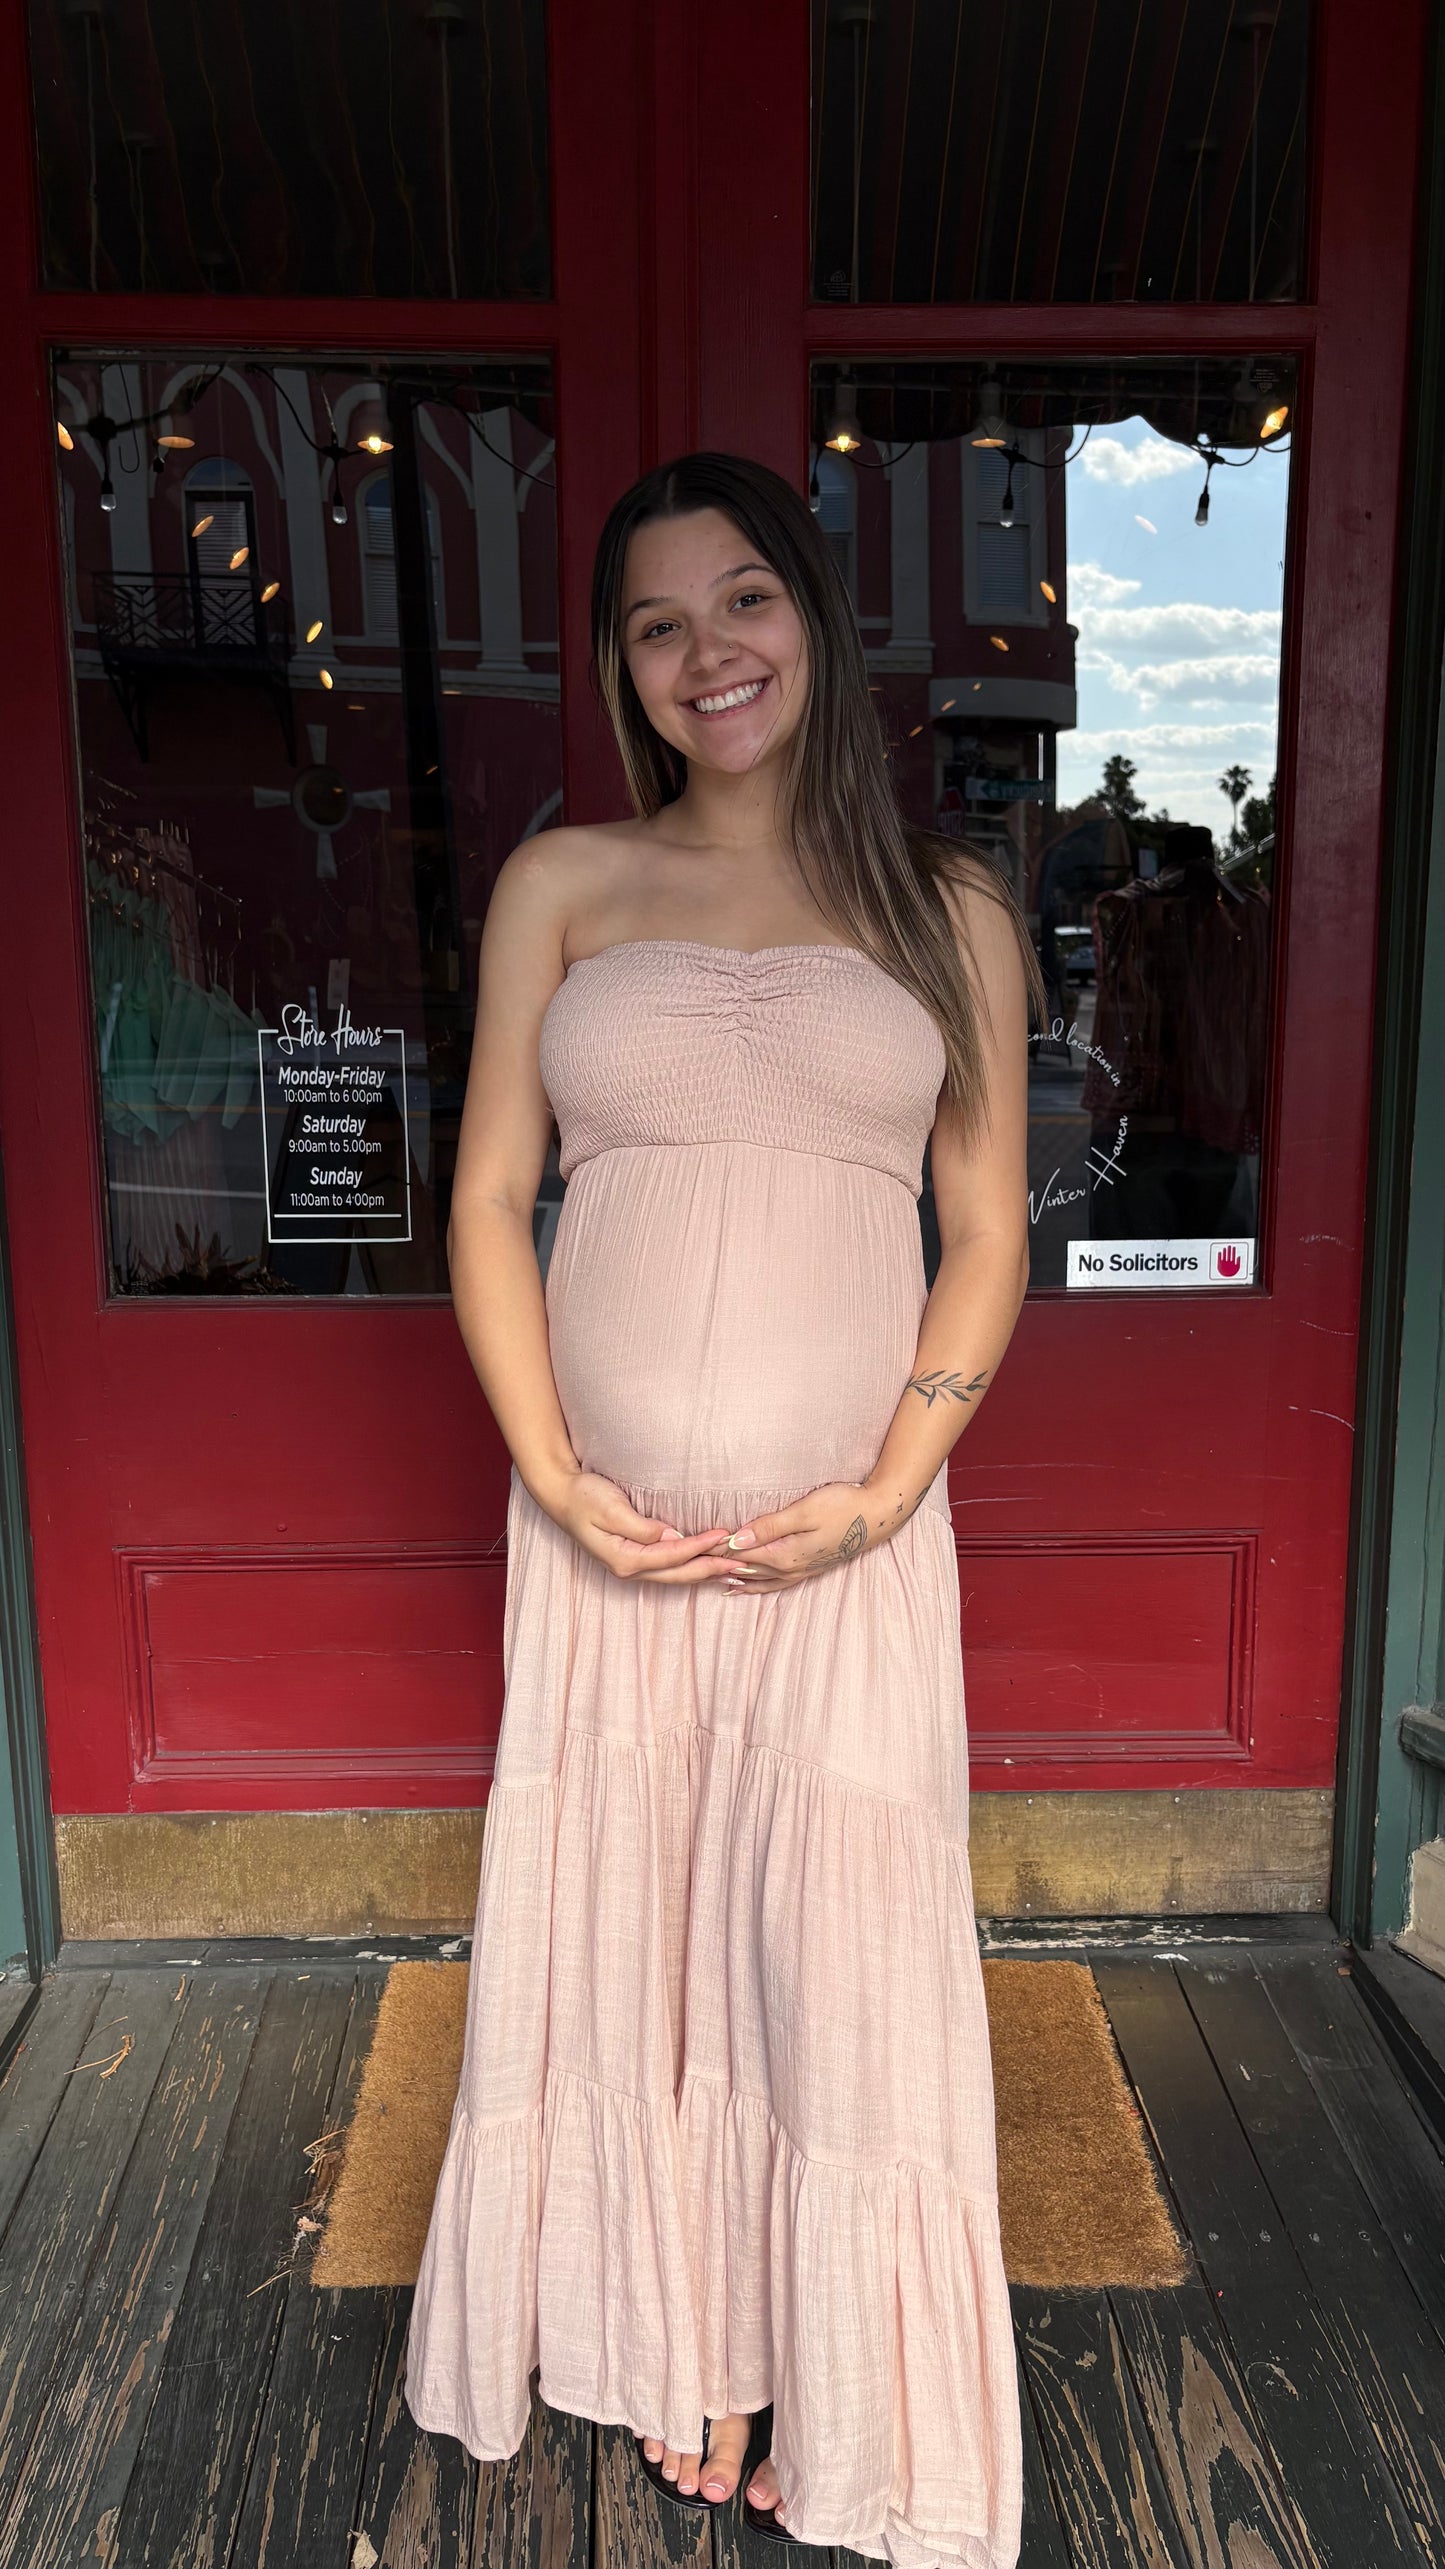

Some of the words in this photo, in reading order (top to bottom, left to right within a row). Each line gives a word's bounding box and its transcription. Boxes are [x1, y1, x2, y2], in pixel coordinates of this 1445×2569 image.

[277, 1003, 327, 1056] Store
[331, 1003, 384, 1056] Hours
[1066, 1022, 1112, 1073] location
[1110, 1072, 1121, 1088] in
[278, 1066, 386, 1089] Monday-Friday
[284, 1089, 327, 1103] 10:00am
[329, 1090, 341, 1103] to
[302, 1114, 366, 1137] Saturday
[288, 1139, 327, 1153] 9:00am
[329, 1140, 341, 1153] to
[1085, 1115, 1128, 1191] Haven
[310, 1166, 363, 1189] Sunday
[290, 1193, 330, 1207] 11:00am
[332, 1194, 343, 1207] to
[1078, 1254, 1104, 1272] No
[1109, 1252, 1199, 1272] Solicitors
